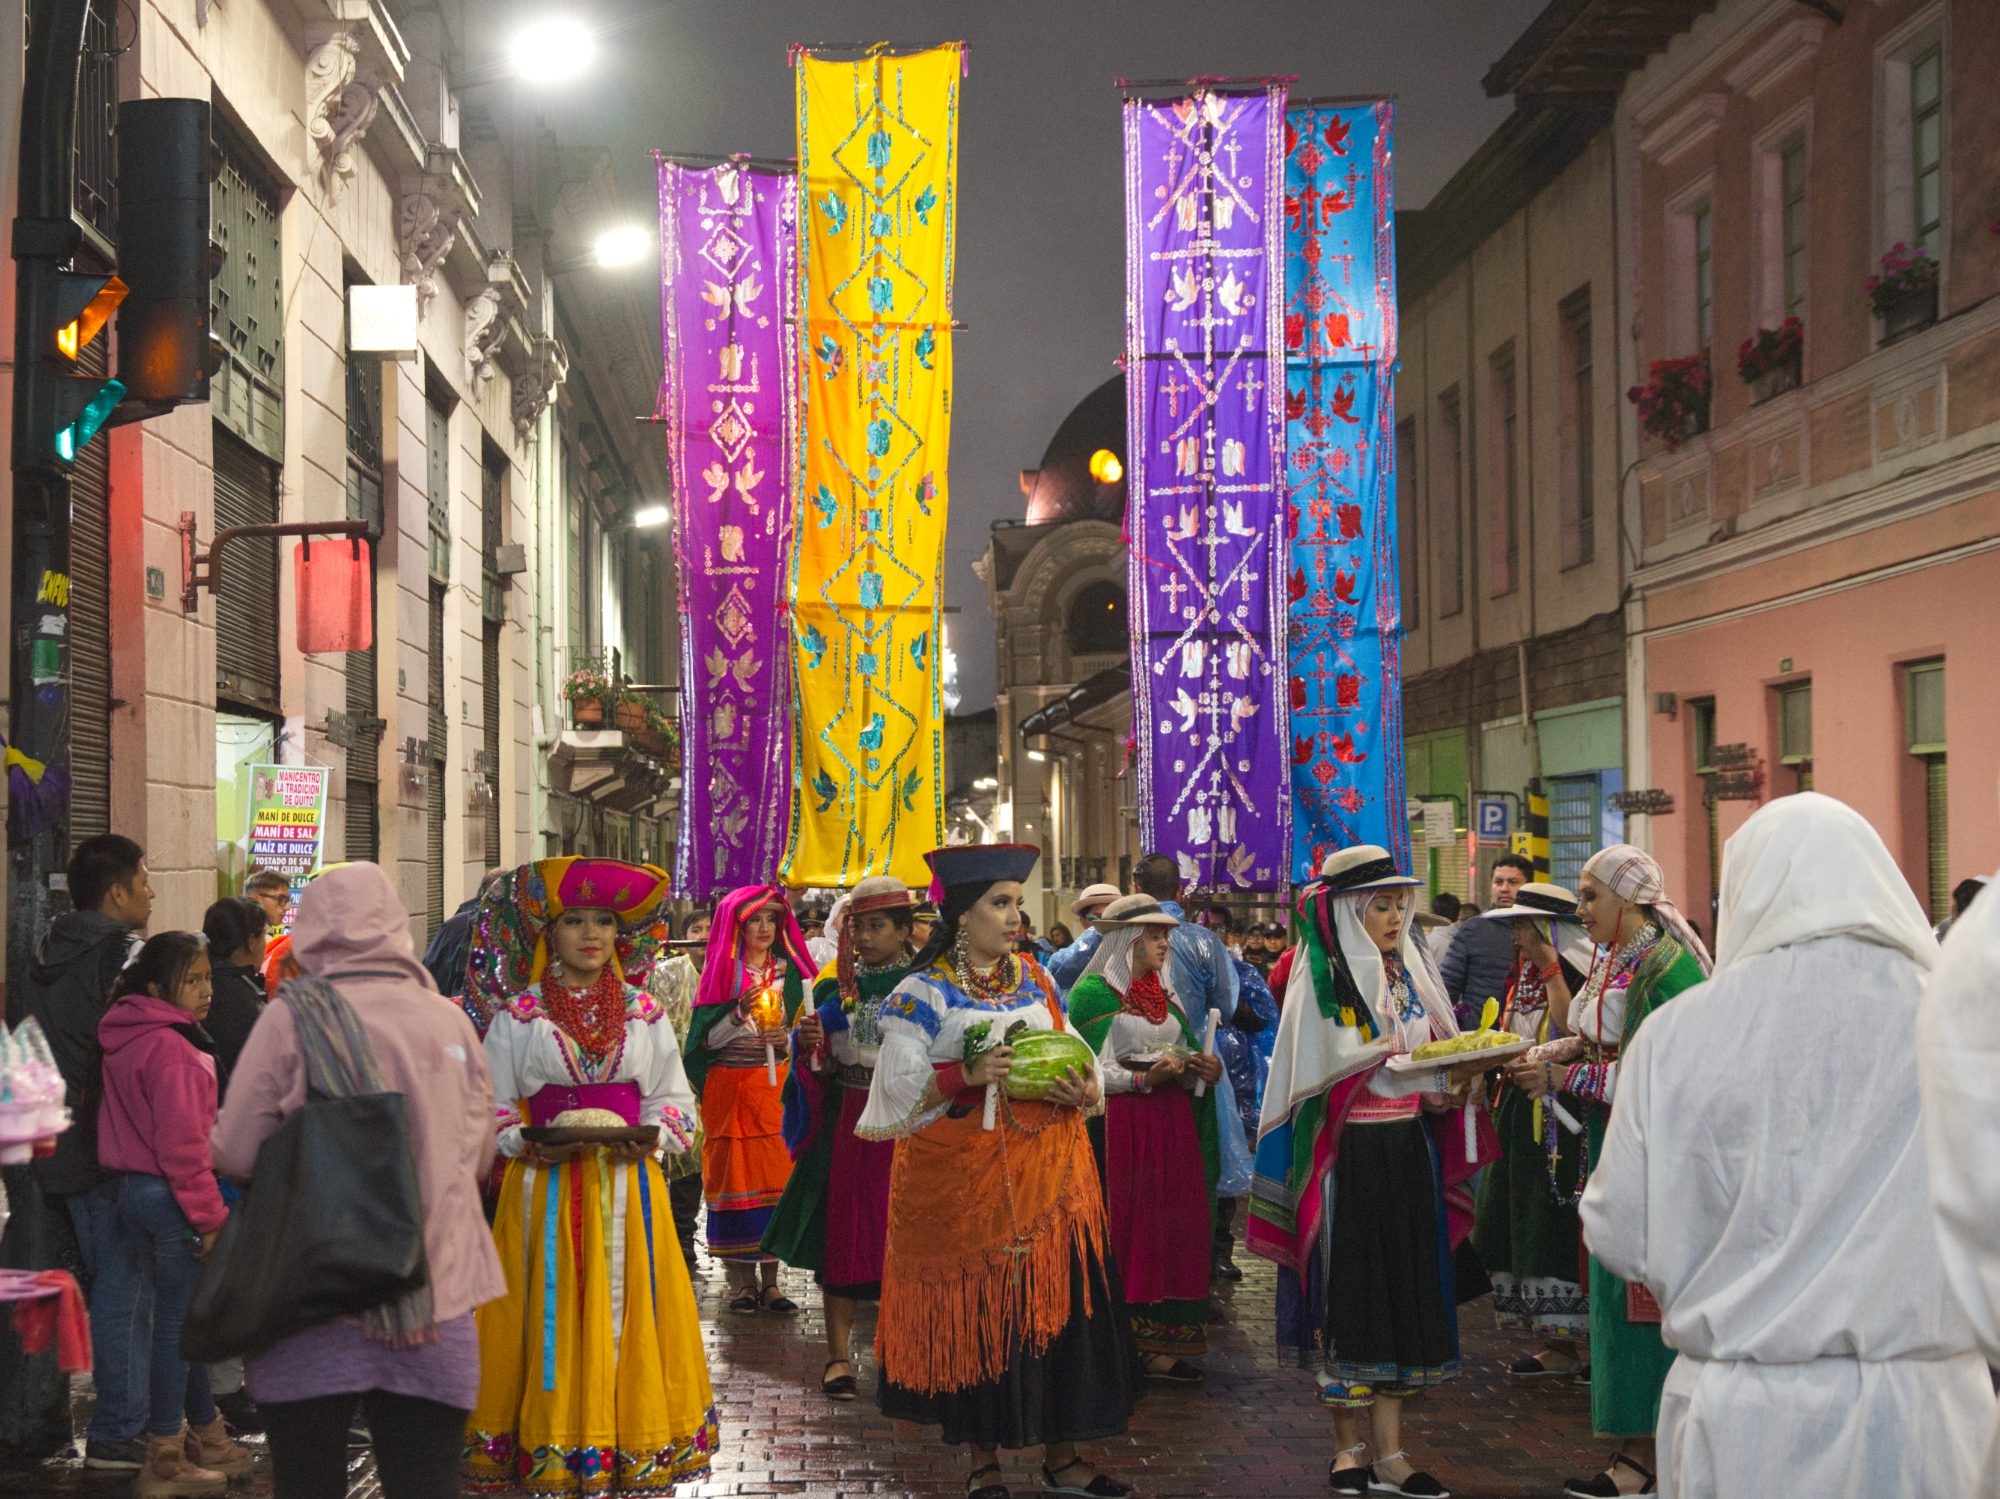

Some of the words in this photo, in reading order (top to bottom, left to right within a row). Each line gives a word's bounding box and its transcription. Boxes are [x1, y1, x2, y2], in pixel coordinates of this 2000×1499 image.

[279, 771, 320, 783] MANICENTRO
[276, 783, 284, 793] LA
[284, 794, 292, 805] DE
[294, 795, 314, 807] QUITO
[258, 809, 279, 821] MANÍ
[281, 812, 290, 822] DE
[293, 812, 314, 823] DULCE
[1485, 805, 1502, 832] P
[255, 824, 280, 838] MANÍ
[283, 827, 295, 838] DE
[297, 827, 313, 839] SAL
[254, 841, 275, 853] MAÍZ
[277, 843, 288, 854] DE
[289, 843, 313, 855] DULCE
[255, 857, 286, 865] TOSTADO
[288, 857, 297, 866] DE
[299, 857, 312, 866] SAL
[281, 866, 304, 874] CUERO
